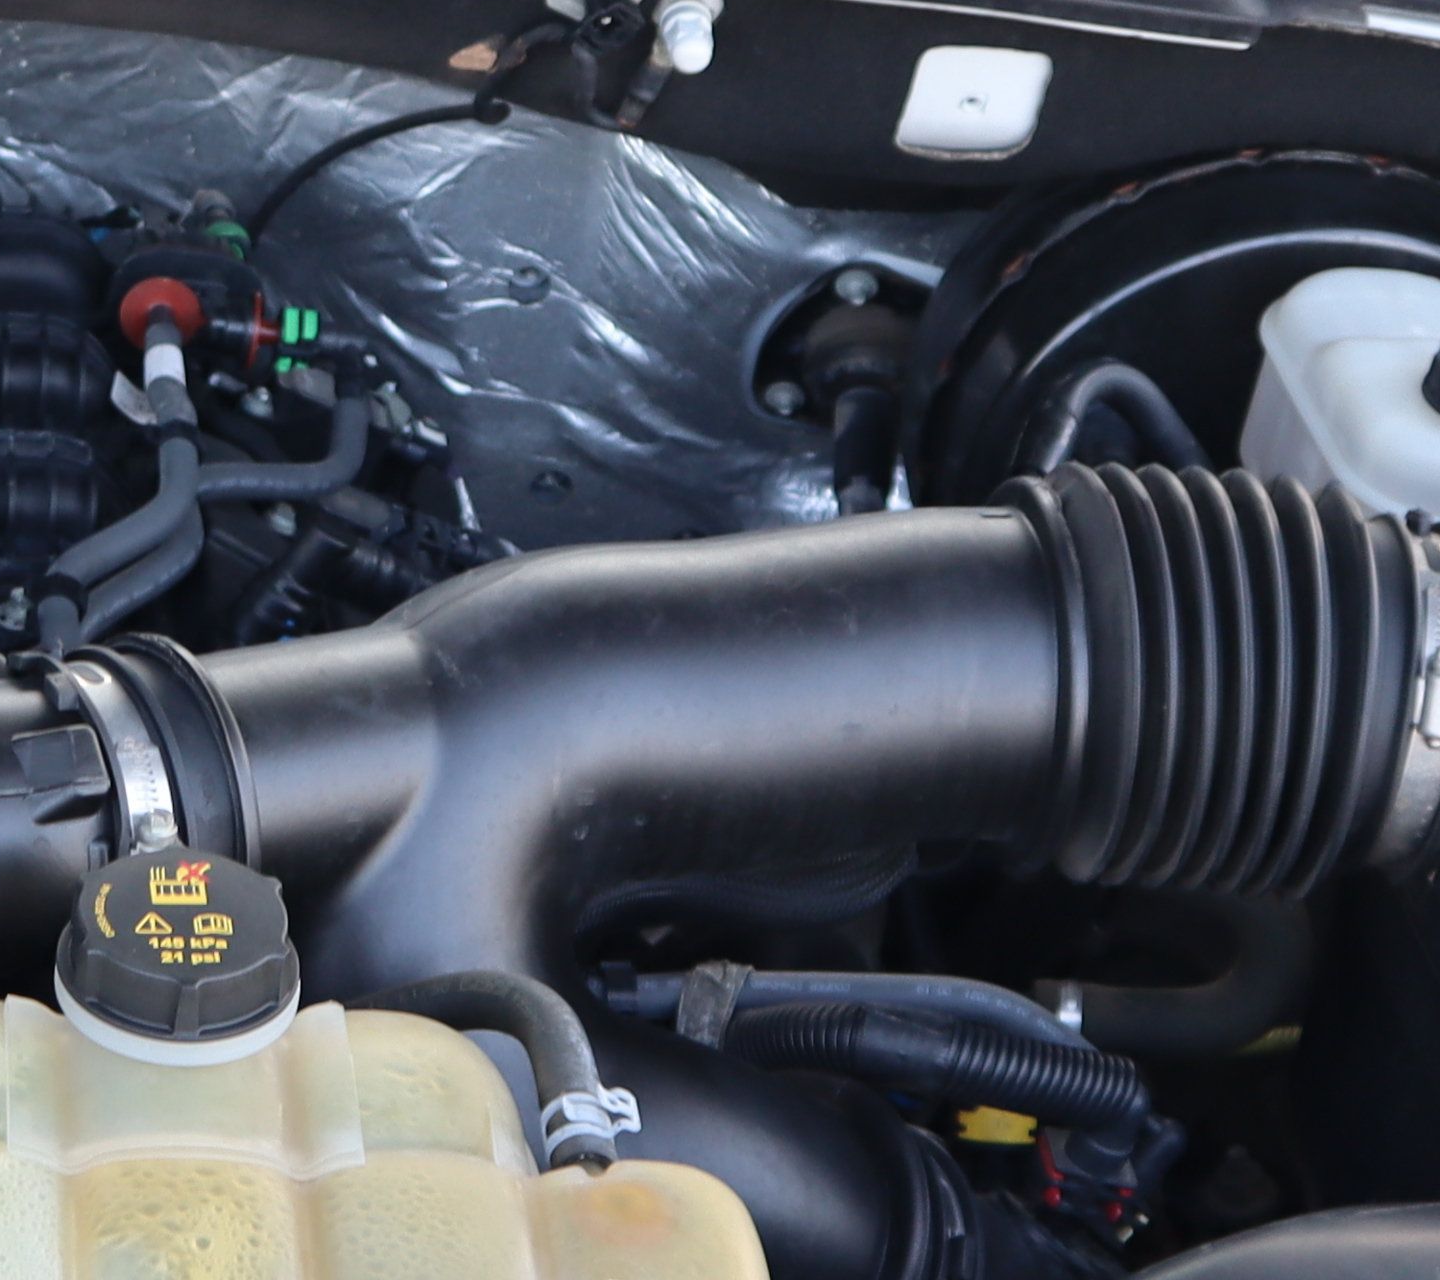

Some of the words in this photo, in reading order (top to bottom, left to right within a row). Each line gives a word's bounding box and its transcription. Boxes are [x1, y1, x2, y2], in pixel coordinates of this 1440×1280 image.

[149, 936, 185, 949] 145
[190, 936, 228, 949] kPa
[161, 951, 184, 963] 21
[191, 951, 221, 966] psi
